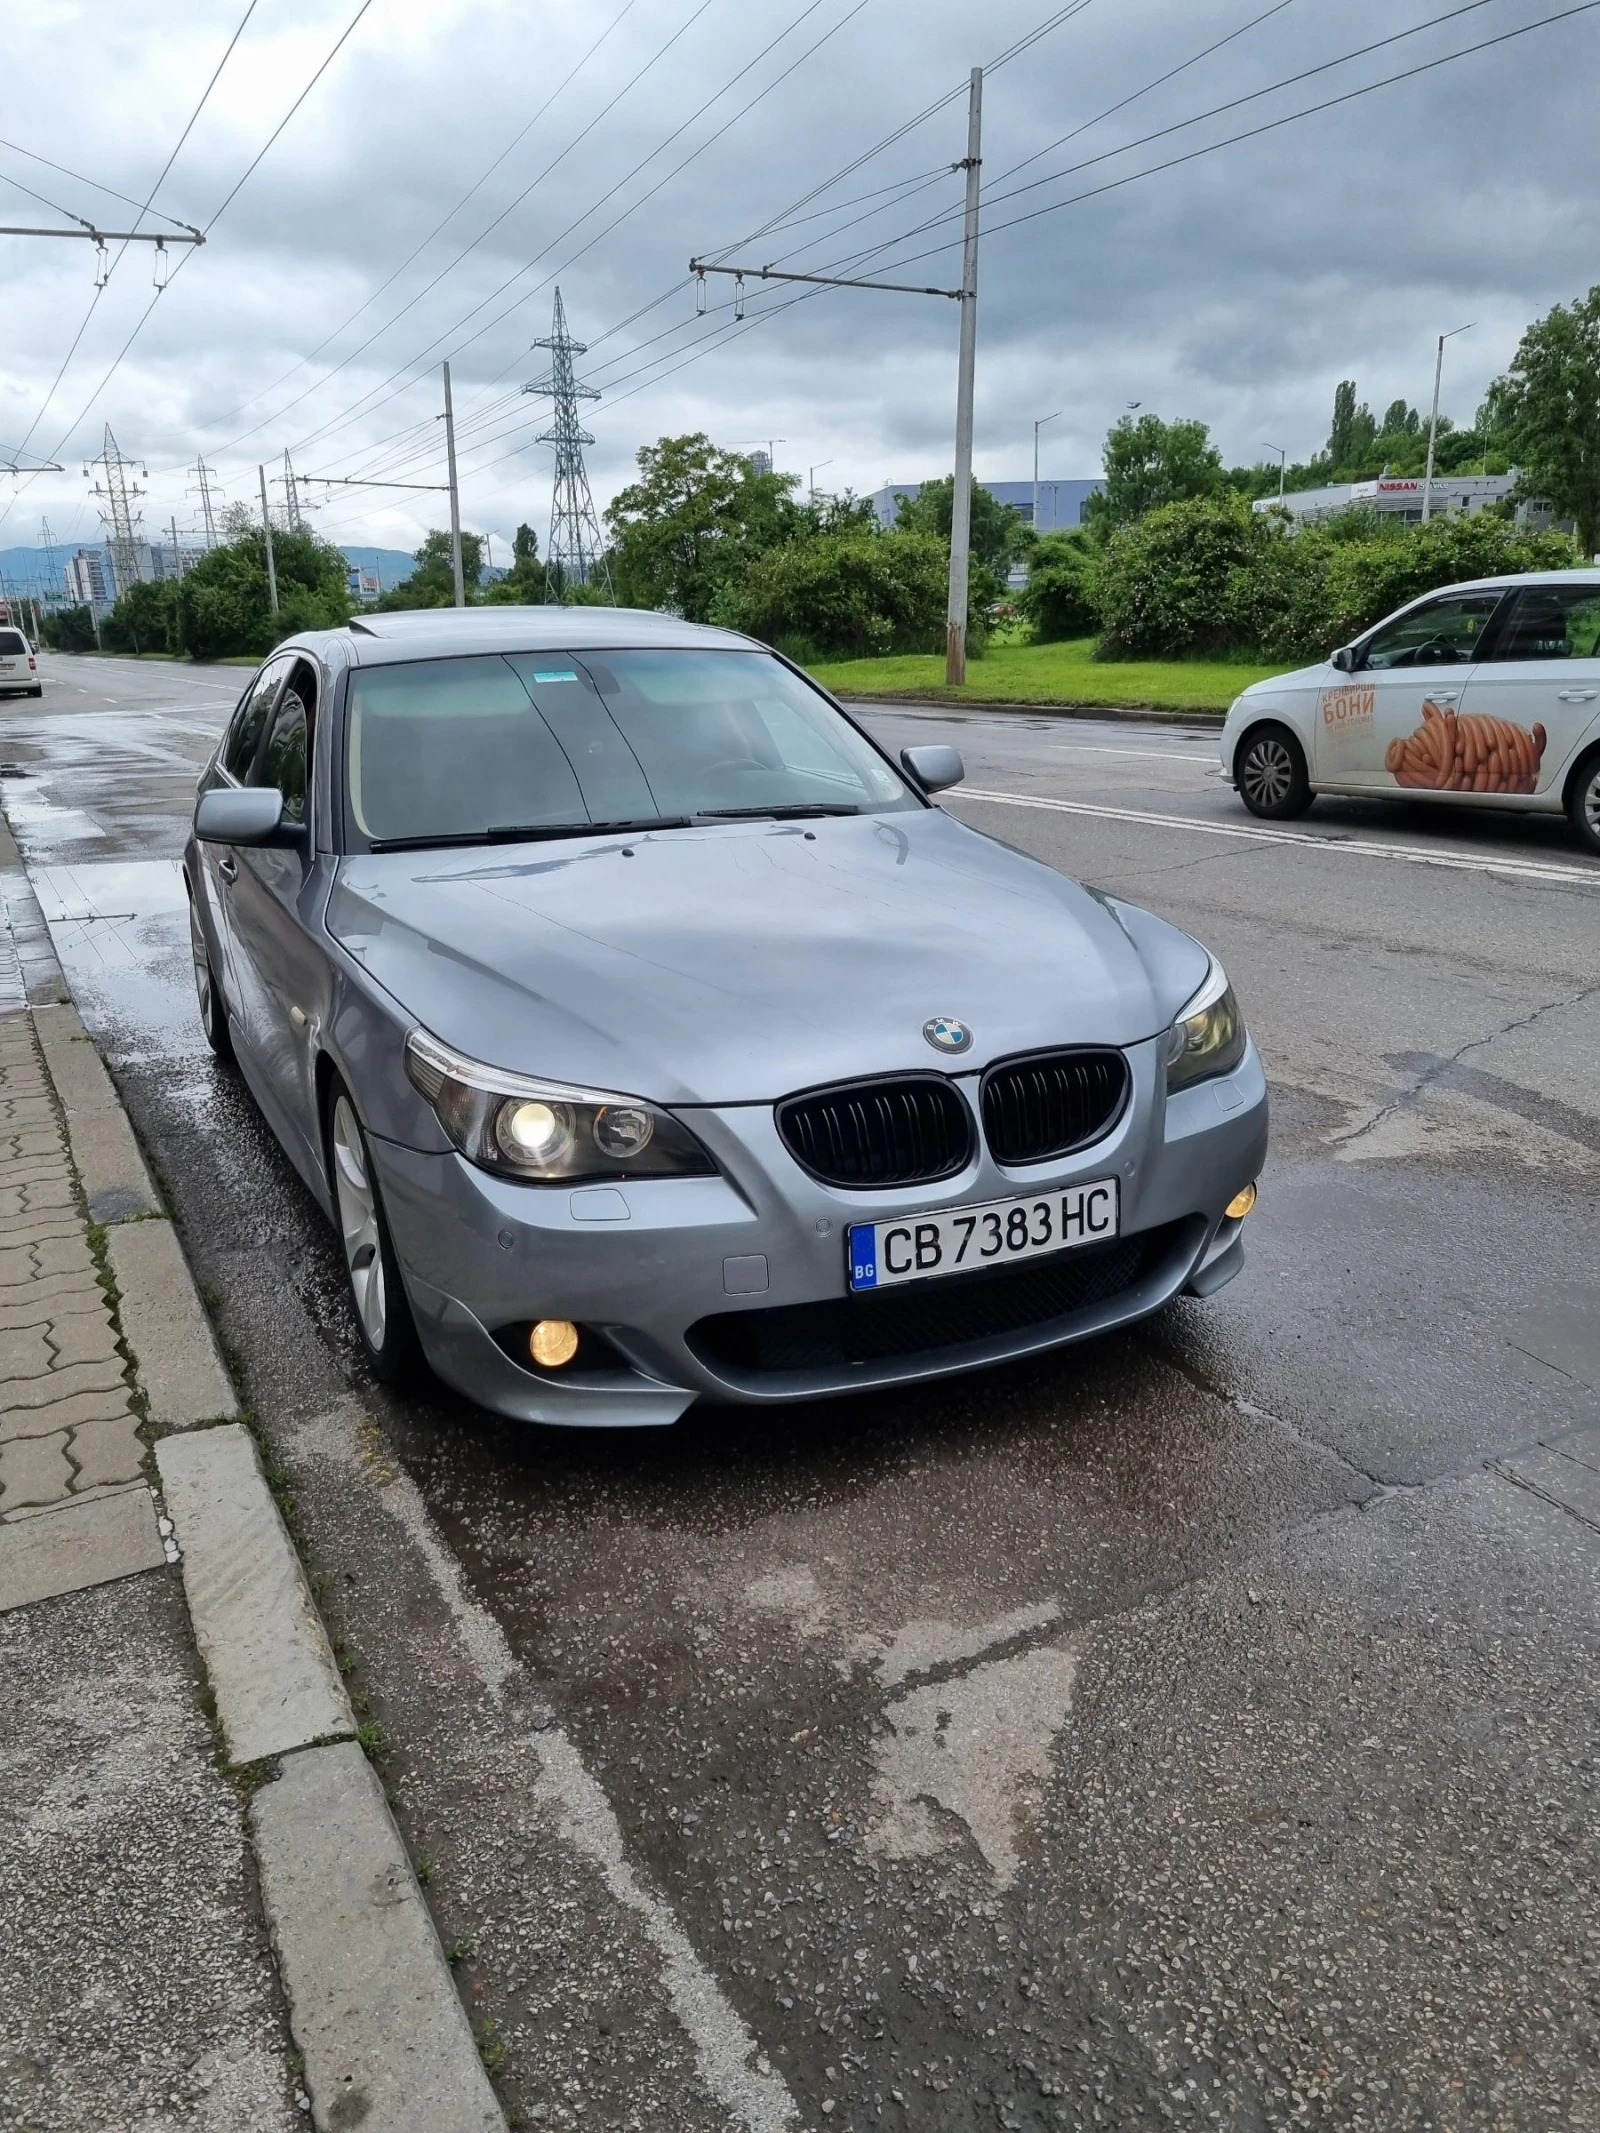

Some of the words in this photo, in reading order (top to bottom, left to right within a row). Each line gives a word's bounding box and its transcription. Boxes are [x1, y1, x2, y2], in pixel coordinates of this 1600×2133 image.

[1379, 482, 1418, 491] NISSAN
[1323, 692, 1375, 725] БОНИ
[927, 1018, 961, 1030] BMW
[884, 1223, 942, 1274] CB
[953, 1202, 1053, 1264] 7383
[1062, 1188, 1109, 1240] HC
[855, 1264, 874, 1280] BG
